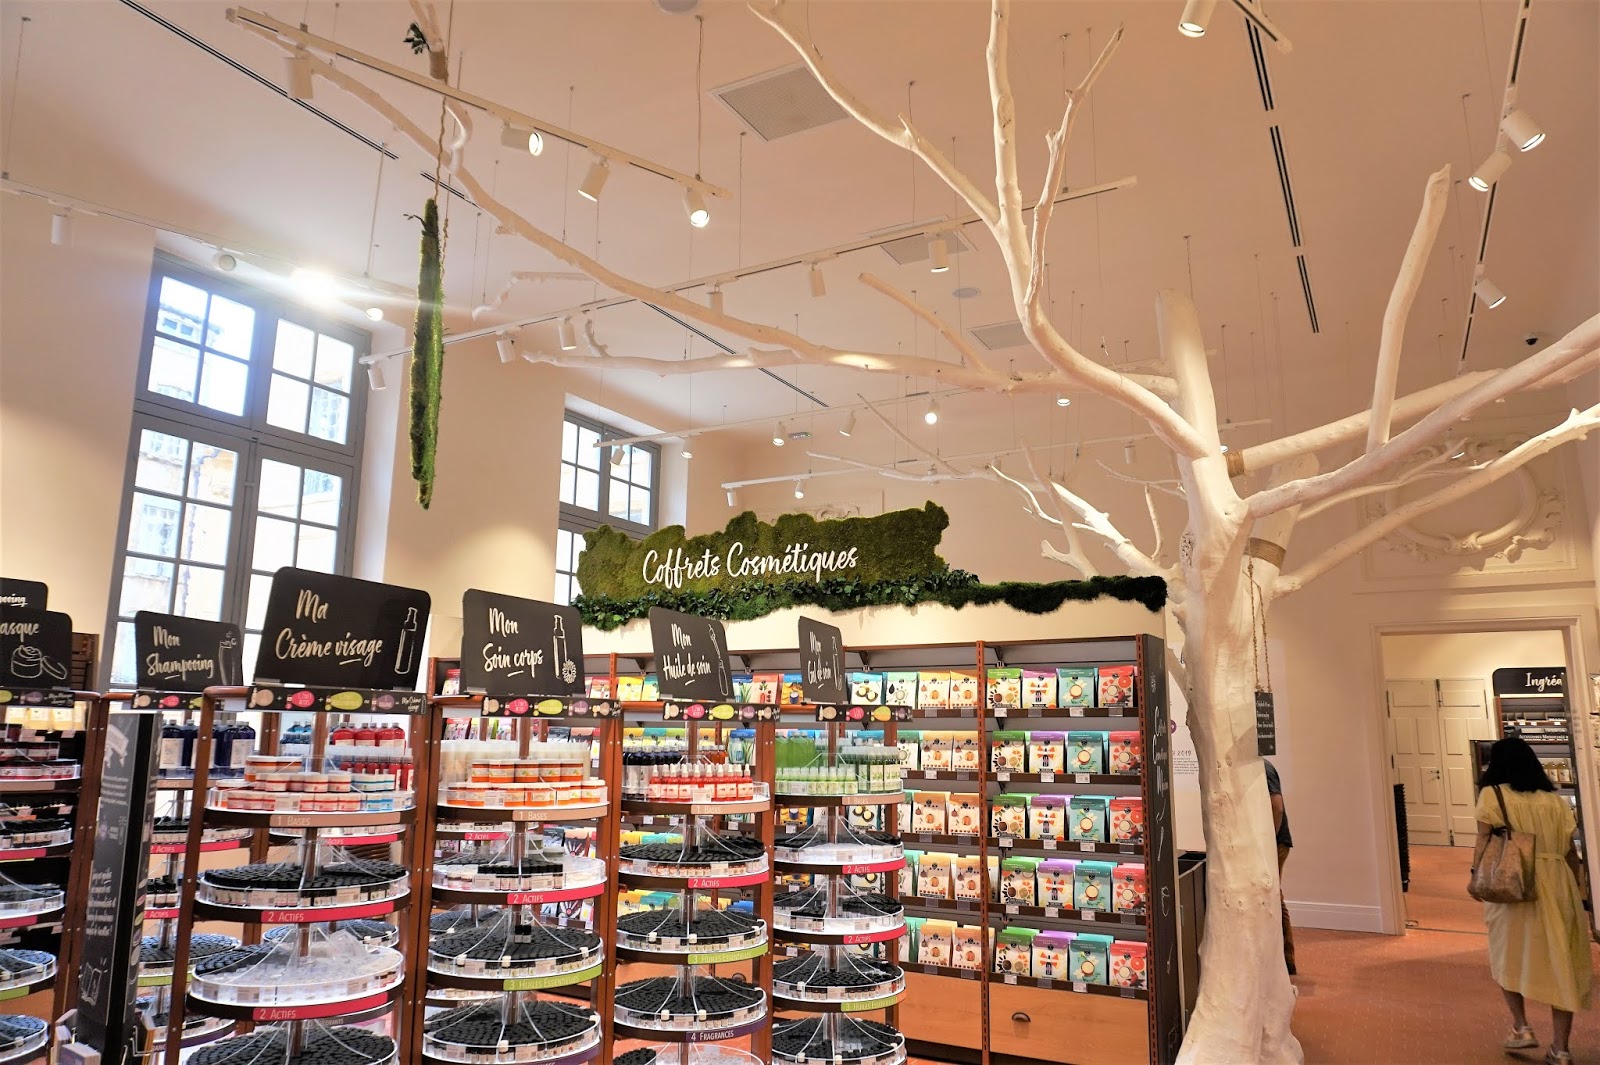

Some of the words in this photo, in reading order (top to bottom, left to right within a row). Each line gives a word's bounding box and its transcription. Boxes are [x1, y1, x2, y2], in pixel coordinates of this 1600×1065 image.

[642, 547, 722, 589] Coffrets
[726, 541, 859, 583] Cosmétiques
[295, 589, 330, 623] Ma
[489, 607, 519, 638] Mon
[153, 625, 180, 649] Mon
[275, 627, 333, 660] Crème
[335, 631, 383, 668] visage
[671, 623, 692, 650] Mon
[146, 652, 214, 681] Shampooing
[482, 642, 511, 673] Soin
[513, 649, 544, 678] corps
[662, 653, 687, 681] Huile
[687, 653, 696, 676] de
[696, 655, 712, 676] soin
[277, 816, 281, 826] 1
[287, 816, 311, 826] BASES
[519, 812, 523, 820] 1
[528, 812, 547, 820] BASES
[693, 879, 698, 887] 2
[701, 879, 720, 887] ACTIFS
[513, 894, 519, 903] 2
[522, 894, 544, 903] ACTIFS
[268, 912, 274, 921] 2
[278, 912, 304, 921] ACTIFS
[510, 980, 515, 989] 3
[519, 979, 543, 989] HUILES
[260, 1008, 266, 1020] 2
[270, 1009, 296, 1019] ACTIFS
[691, 1032, 696, 1041] 4
[700, 1030, 734, 1041] FRAGRANCES
